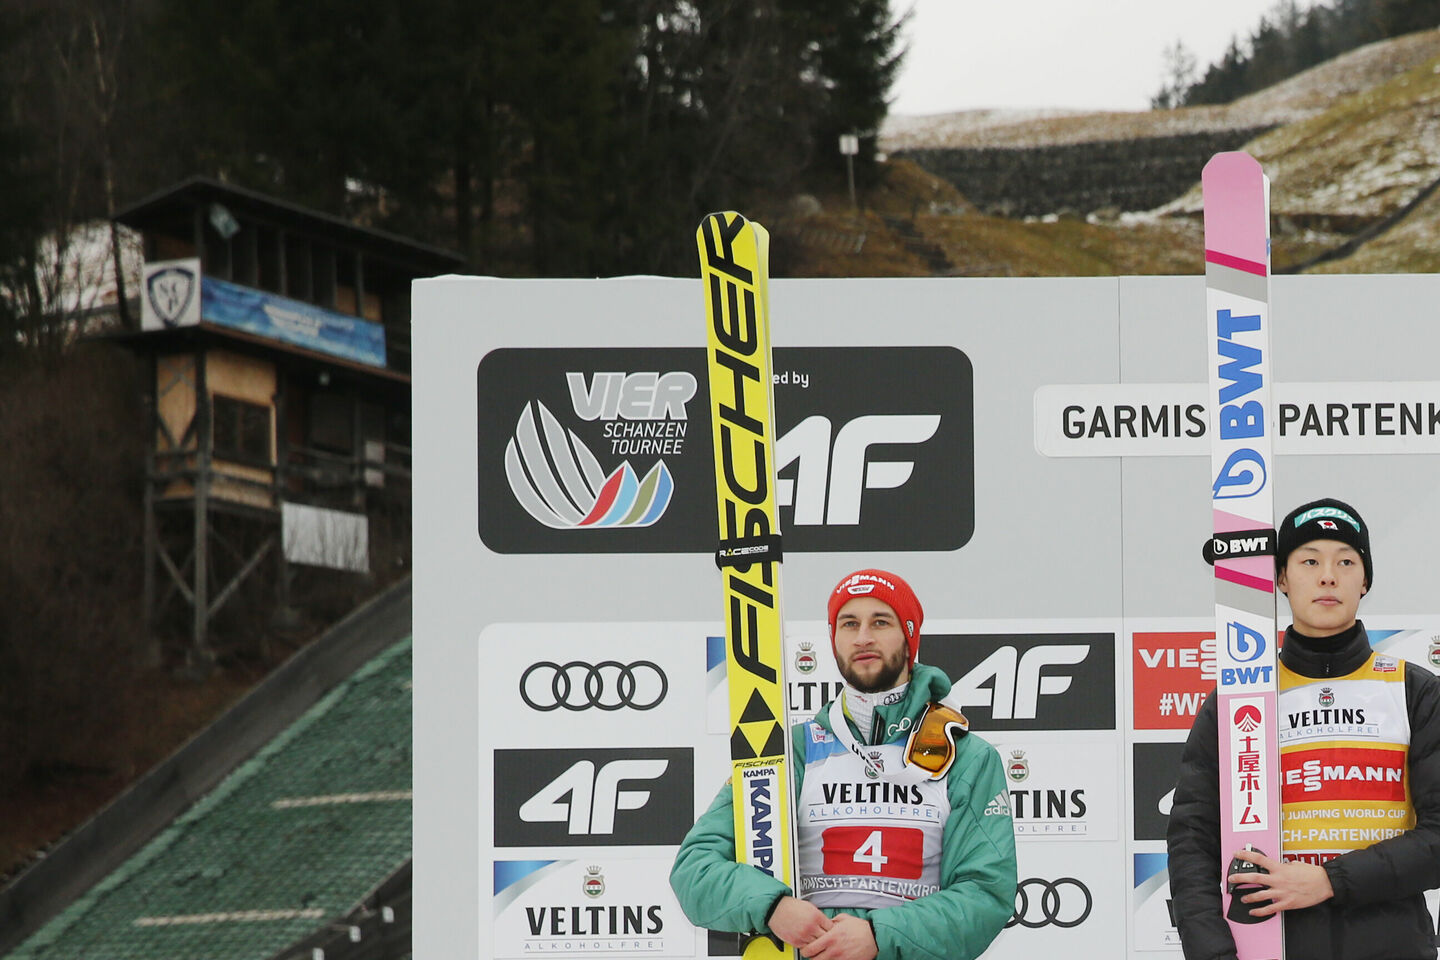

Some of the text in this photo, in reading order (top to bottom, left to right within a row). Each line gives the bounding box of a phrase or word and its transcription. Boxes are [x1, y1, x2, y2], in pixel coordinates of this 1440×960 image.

[792, 371, 810, 388] by
[1216, 309, 1265, 440] BWT
[565, 372, 698, 422] VIER
[603, 422, 688, 438] SCHANZEN
[611, 439, 684, 455] TOURNEE
[701, 213, 776, 685] FISCHER
[1230, 537, 1268, 554] BWT
[953, 645, 1091, 719] 4F
[1221, 666, 1273, 686] BWT
[1288, 708, 1366, 729] VELTINS
[734, 757, 784, 769] FISCHER
[743, 768, 776, 778] KAMPA
[1238, 736, 1261, 825] 土屋ホーム
[1280, 759, 1402, 792] ESSMANN
[519, 760, 670, 835] 4F
[822, 782, 923, 805] VELTINS
[1010, 790, 1087, 818] TINS
[809, 805, 941, 819] ALKOHOLFREI
[1288, 808, 1406, 820] JUMPING WORLD CUP
[1018, 825, 1087, 833] OLFREI
[853, 830, 888, 873] 4
[526, 904, 664, 937] VELTINS
[524, 941, 664, 952] ALKOHOLFREI
